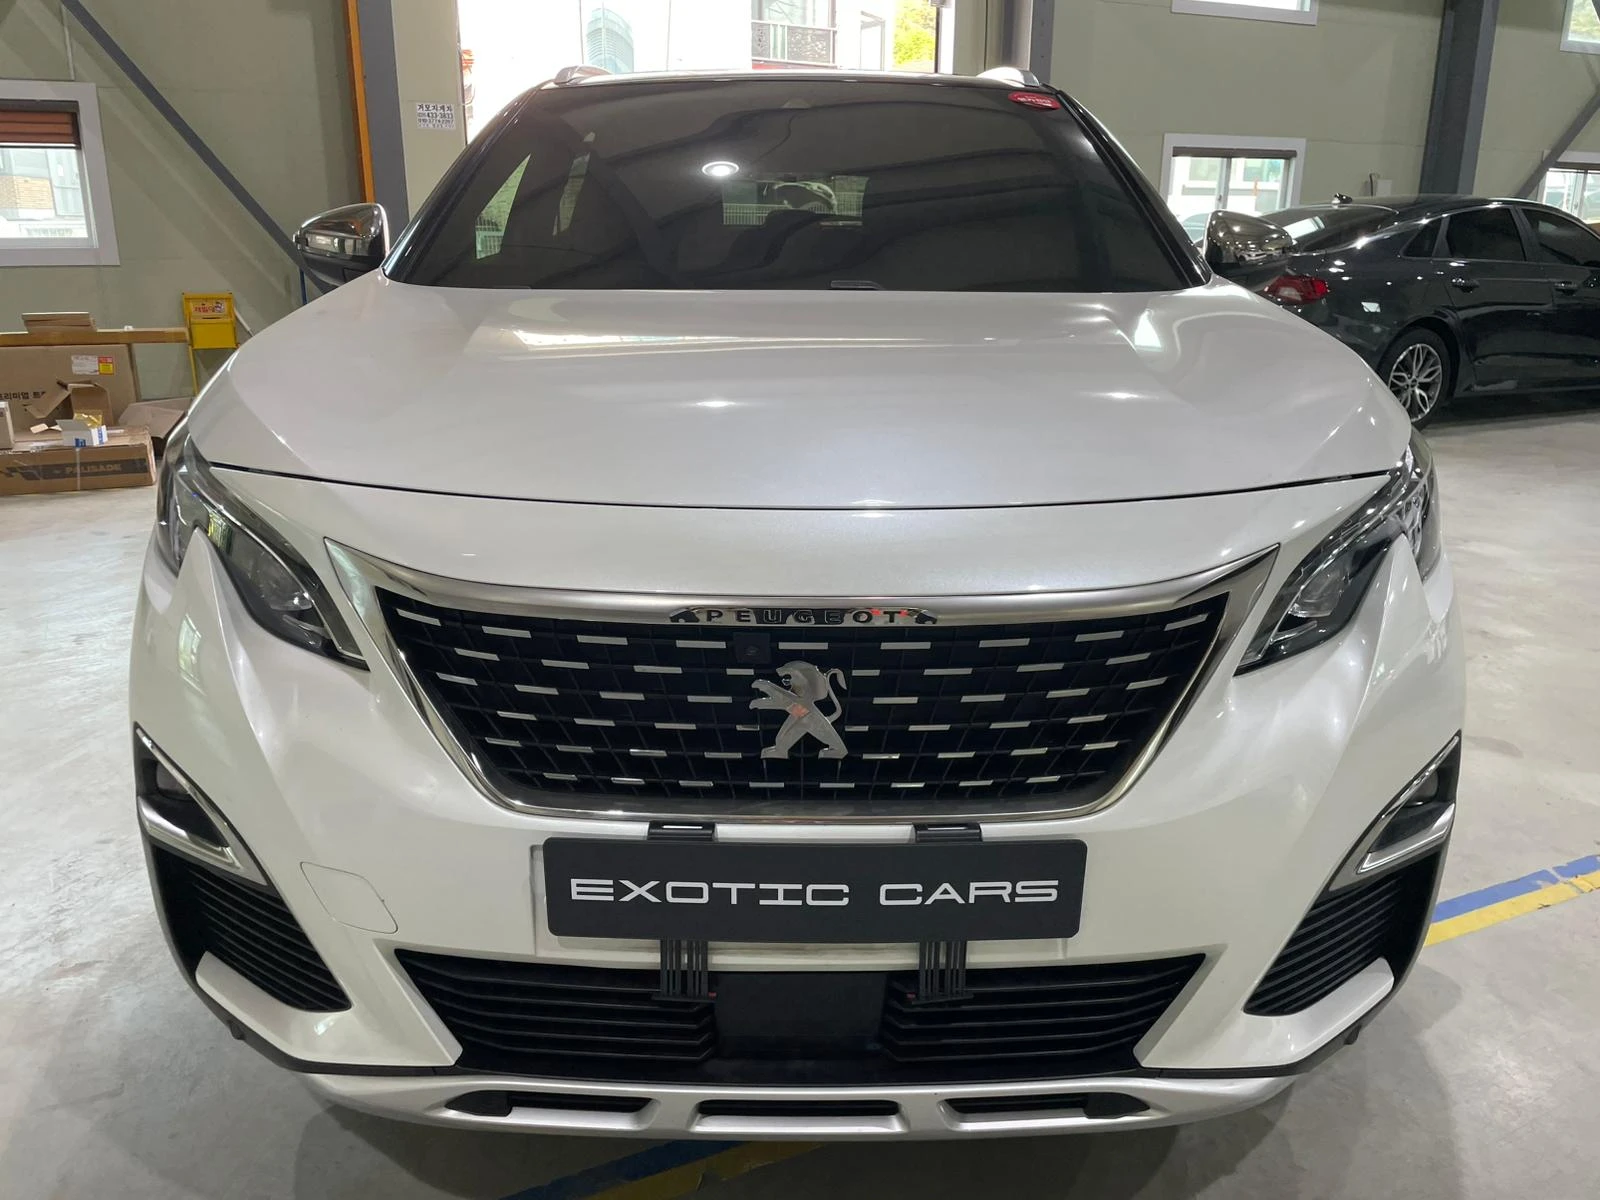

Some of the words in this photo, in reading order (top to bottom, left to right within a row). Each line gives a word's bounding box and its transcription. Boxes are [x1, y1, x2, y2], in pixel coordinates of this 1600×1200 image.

[706, 609, 902, 624] PEUGEOT
[571, 878, 850, 906] EXOTIC
[880, 880, 1059, 905] CARS
